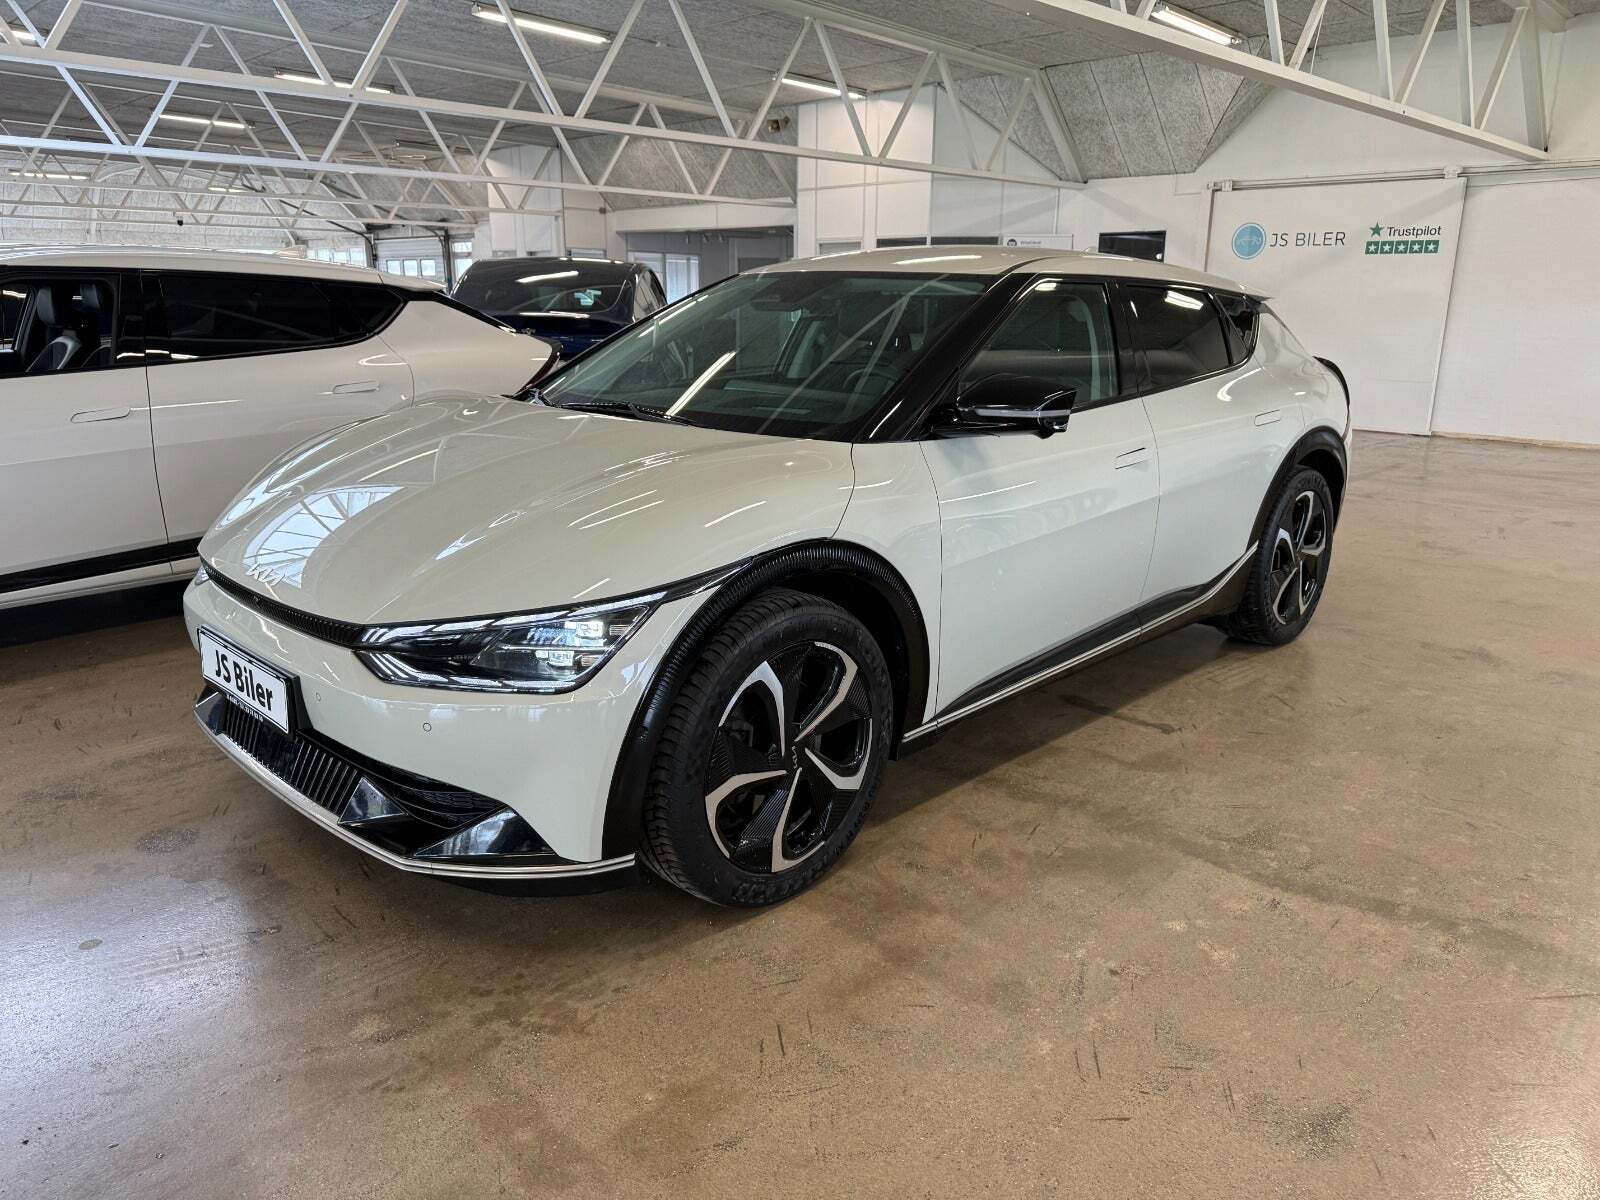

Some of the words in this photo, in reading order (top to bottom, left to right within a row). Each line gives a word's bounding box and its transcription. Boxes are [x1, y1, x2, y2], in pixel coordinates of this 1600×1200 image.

[1269, 232, 1289, 248] JS
[1295, 231, 1346, 247] BILER
[1387, 225, 1442, 239] Trustpilot
[215, 649, 232, 684] JS
[232, 660, 273, 712] Biler
